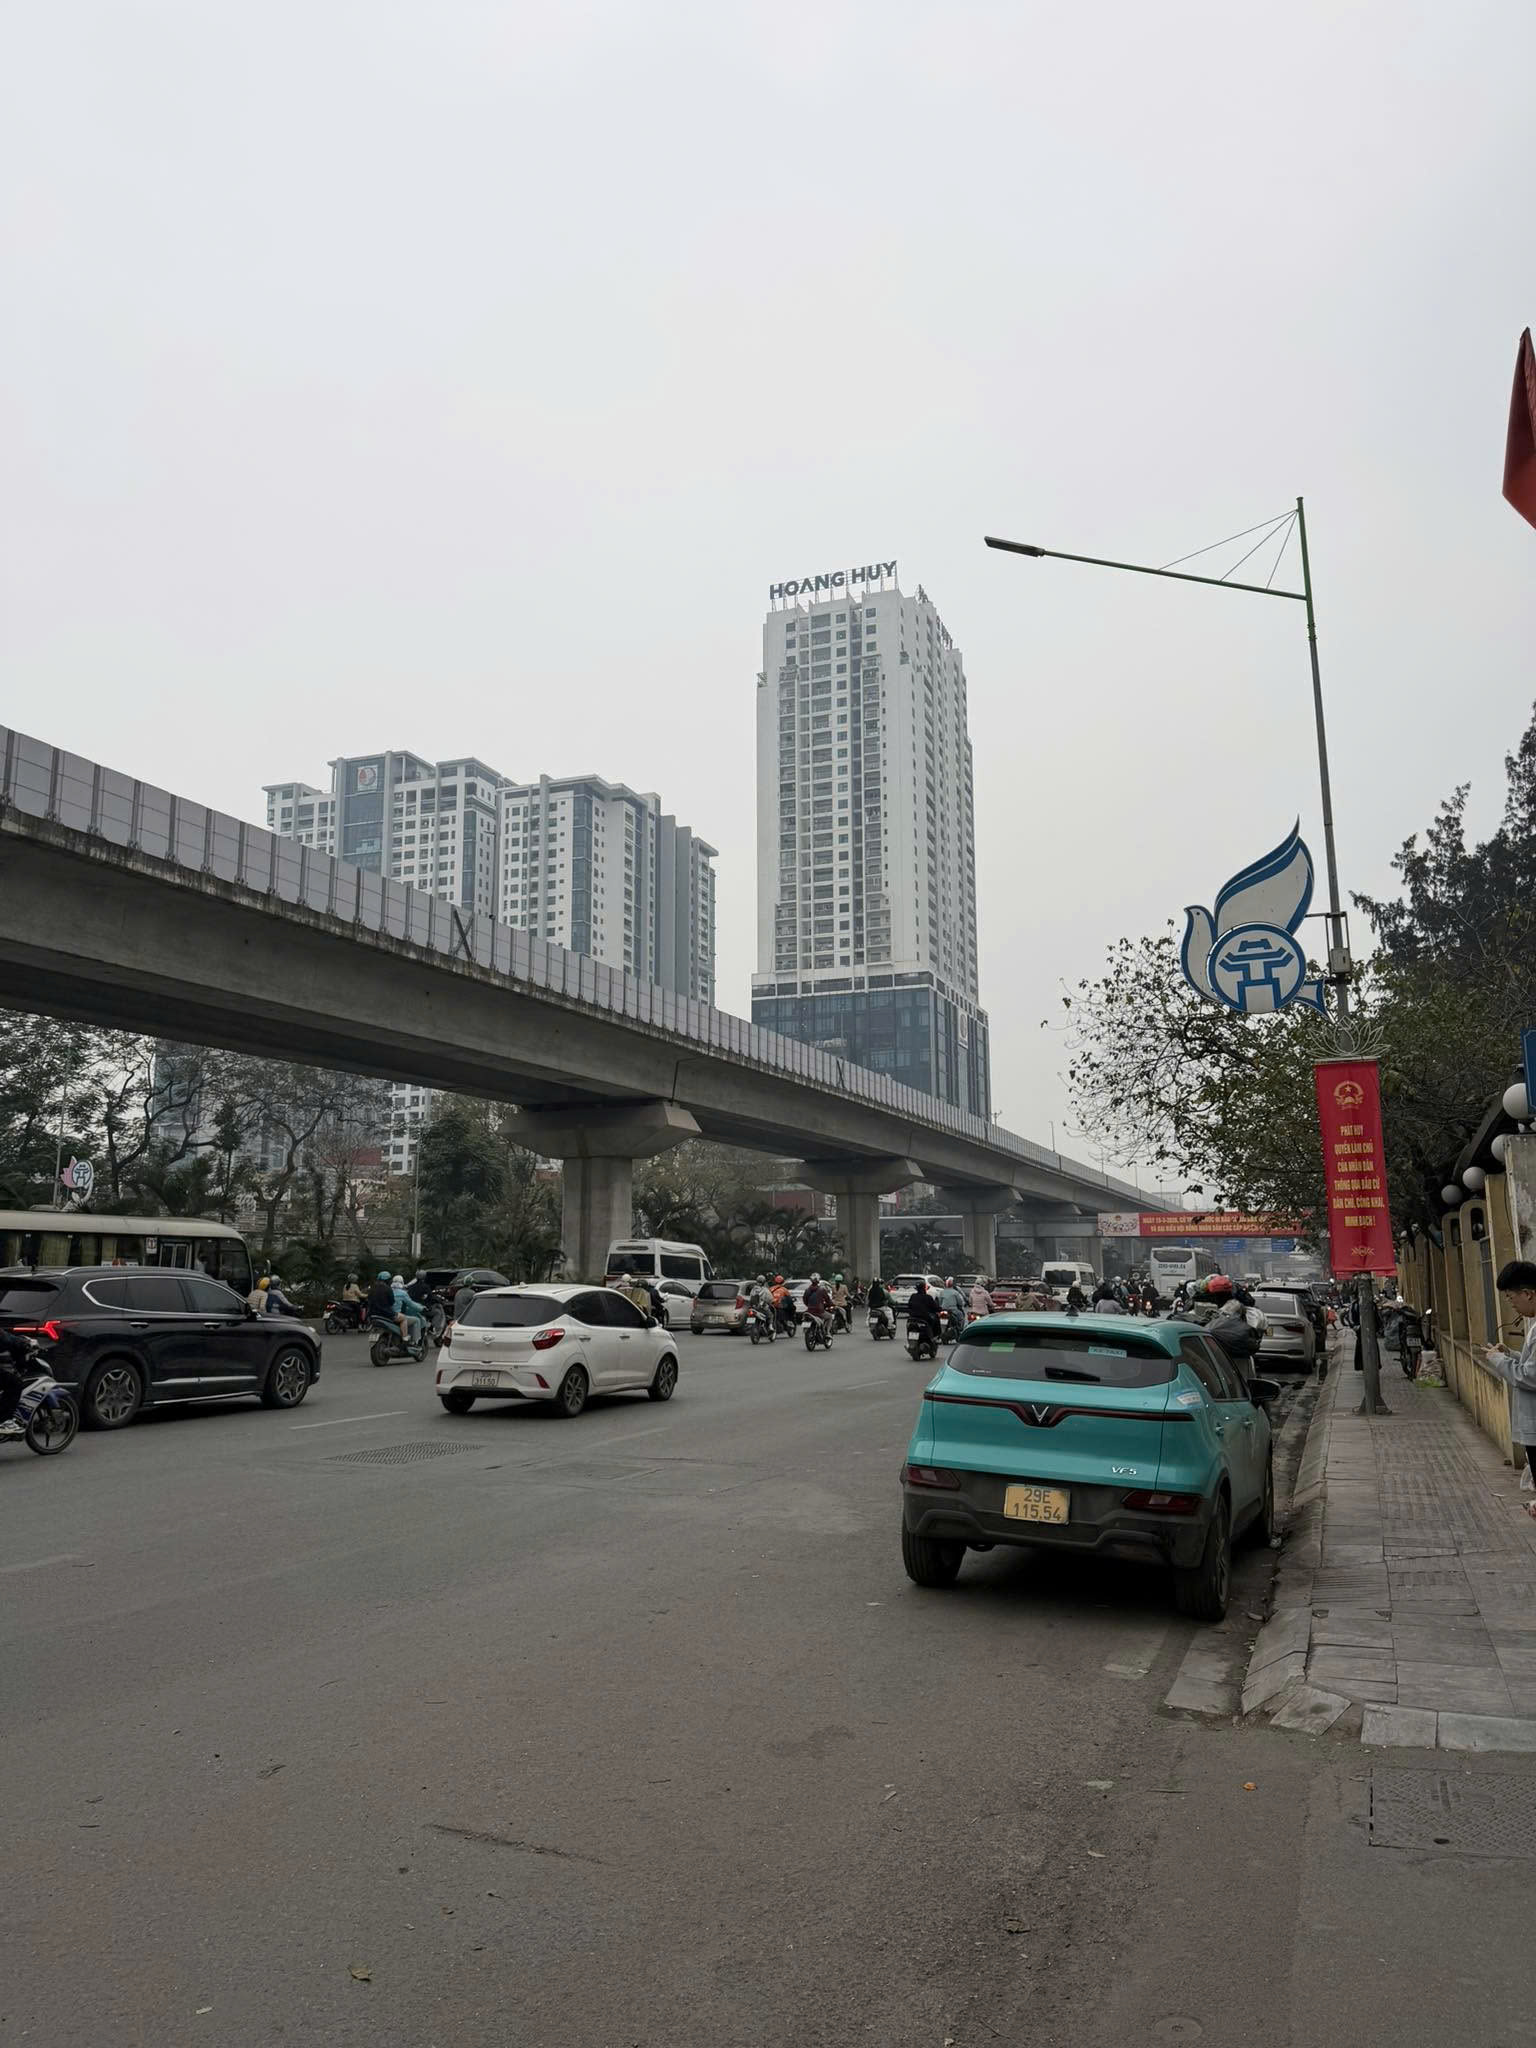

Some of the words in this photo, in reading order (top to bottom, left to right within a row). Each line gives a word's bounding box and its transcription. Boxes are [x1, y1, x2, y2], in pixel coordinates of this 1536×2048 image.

[769, 571, 845, 600] HOANG
[851, 560, 897, 584] HUY
[1023, 1488, 1052, 1504] 29E
[1012, 1502, 1062, 1521] 115.54
